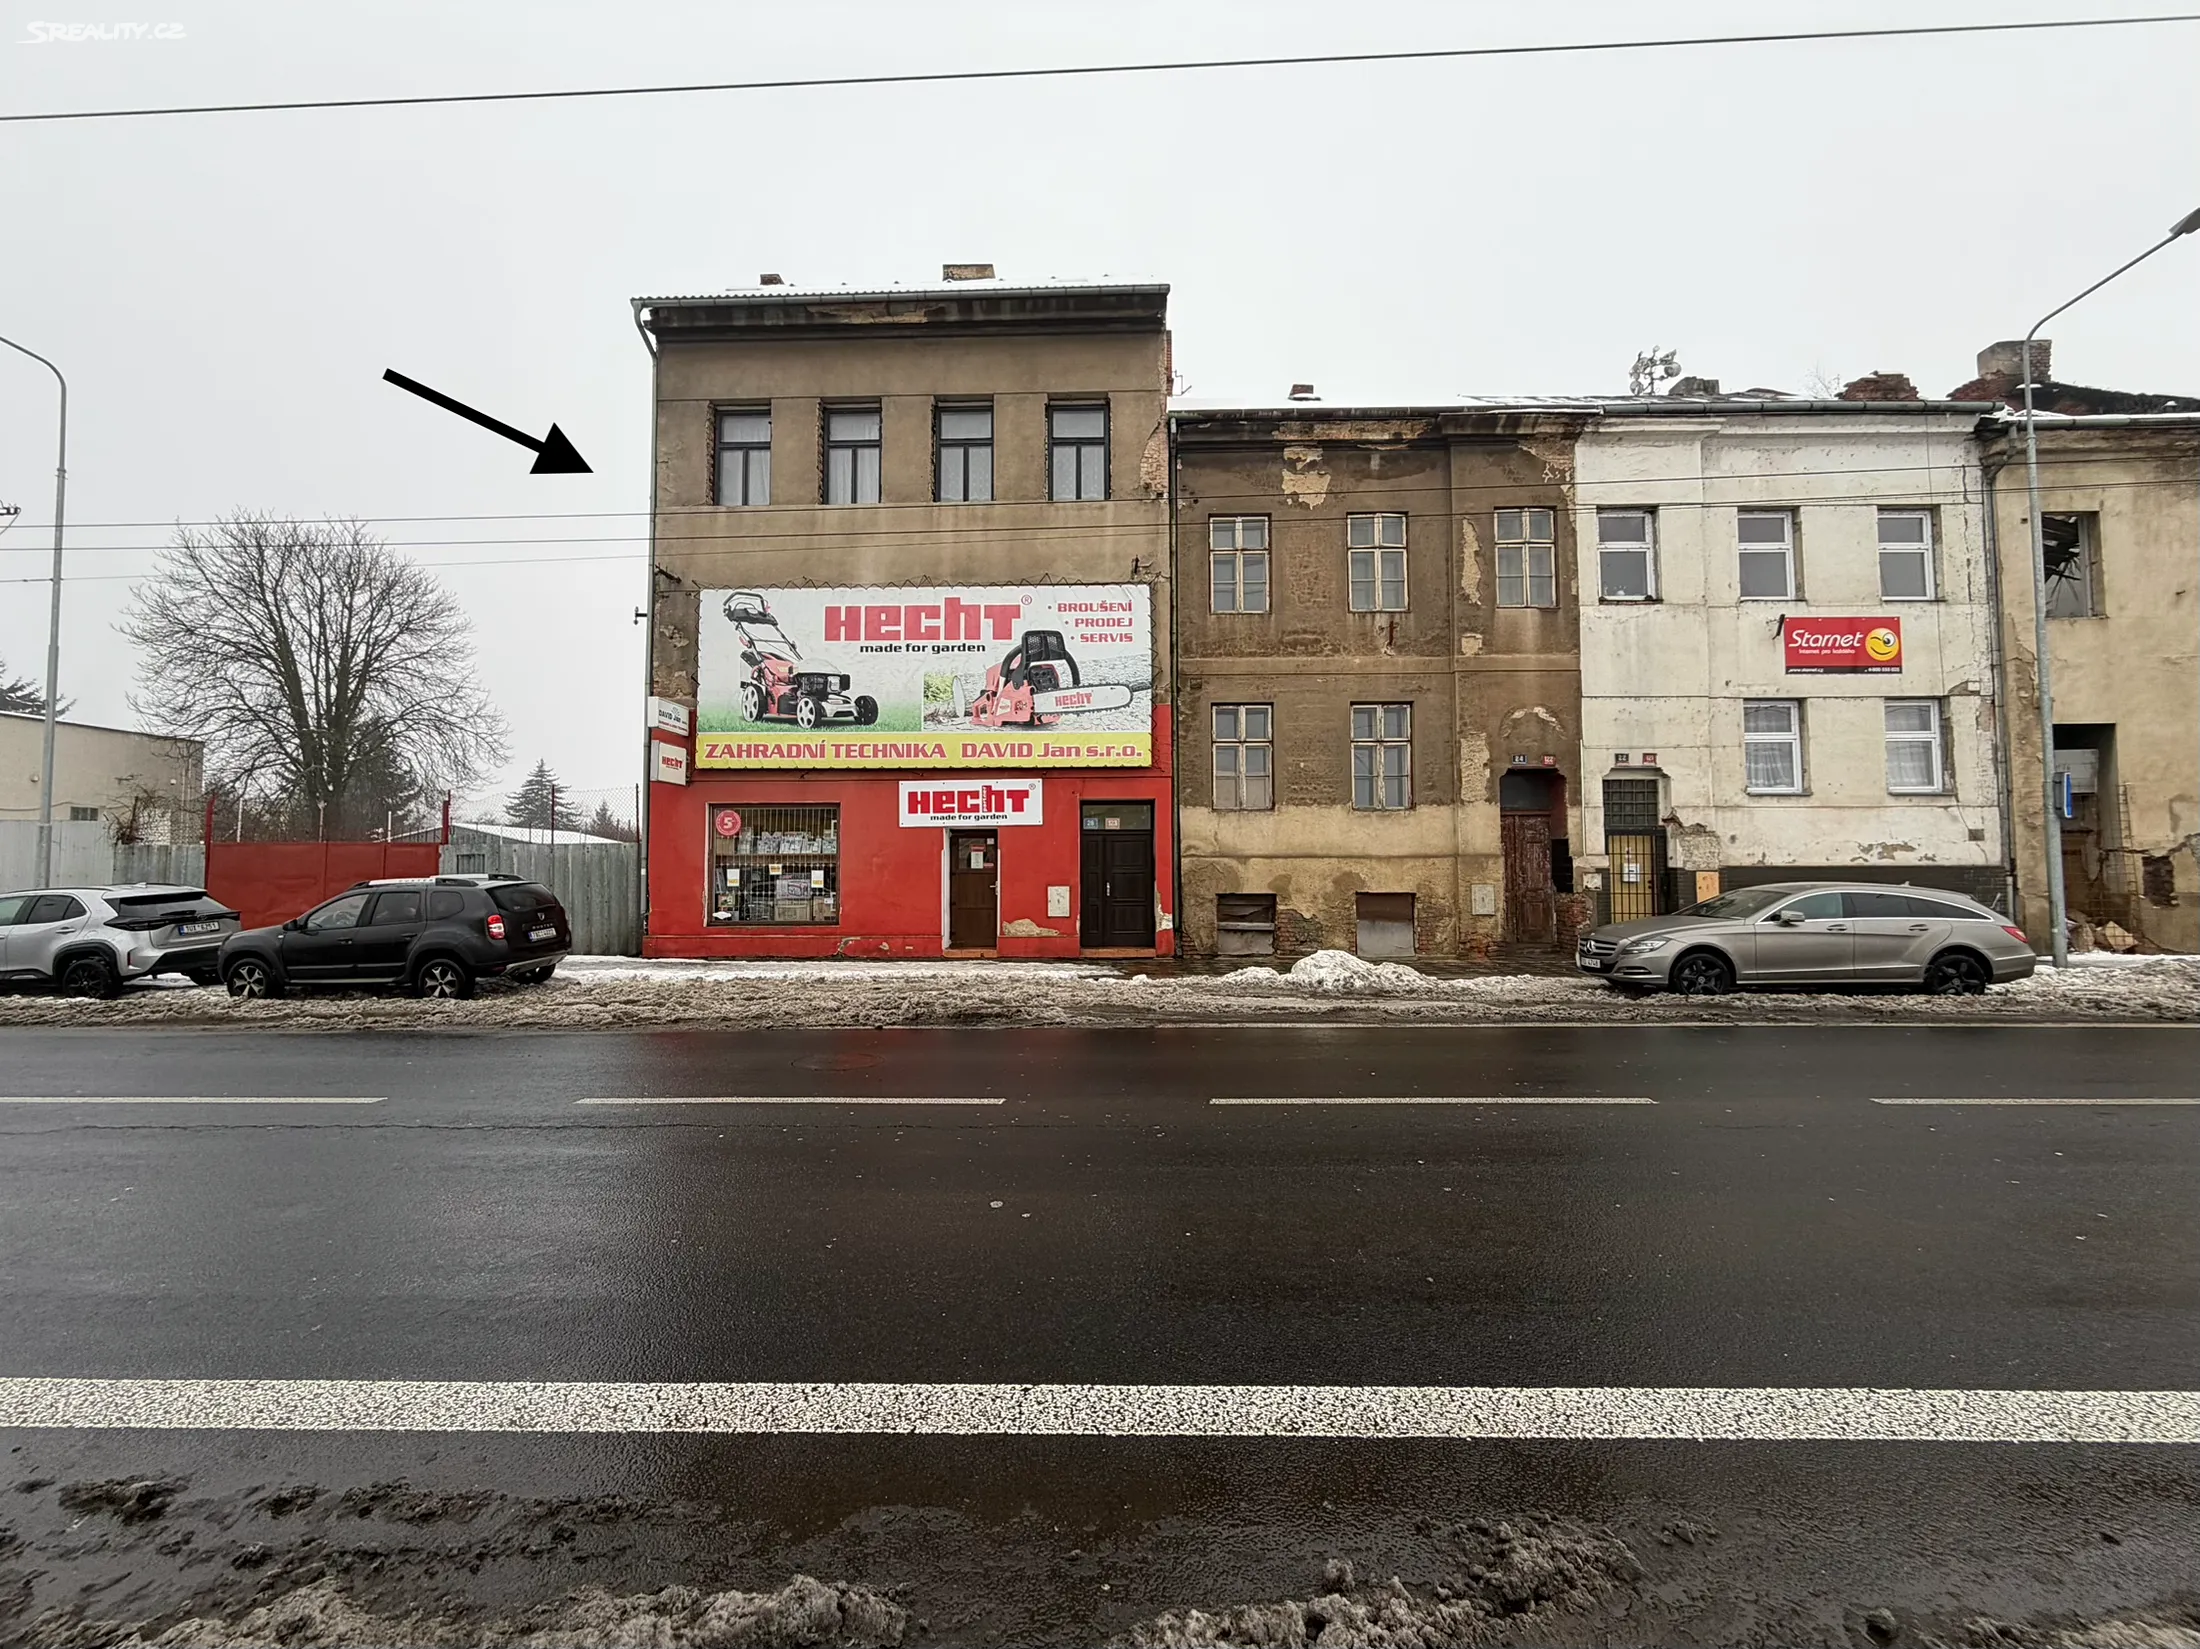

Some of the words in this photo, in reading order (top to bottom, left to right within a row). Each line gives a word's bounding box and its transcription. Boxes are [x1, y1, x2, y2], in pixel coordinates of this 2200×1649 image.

[1057, 600, 1133, 612] BROUŠENÍ
[1074, 618, 1133, 627] PRODEJ
[1080, 633, 1133, 642] SERVIS
[1788, 629, 1864, 647] Starnet
[860, 643, 902, 653] made
[905, 643, 927, 653] for
[932, 643, 986, 655] garden
[705, 740, 826, 759] ZAHRADNÍ
[830, 743, 947, 759] TECHNIKA
[961, 743, 1033, 758] DAVID
[1037, 743, 1082, 758] Jan
[1086, 745, 1142, 757] s.r.o.
[974, 813, 1008, 822] garden
